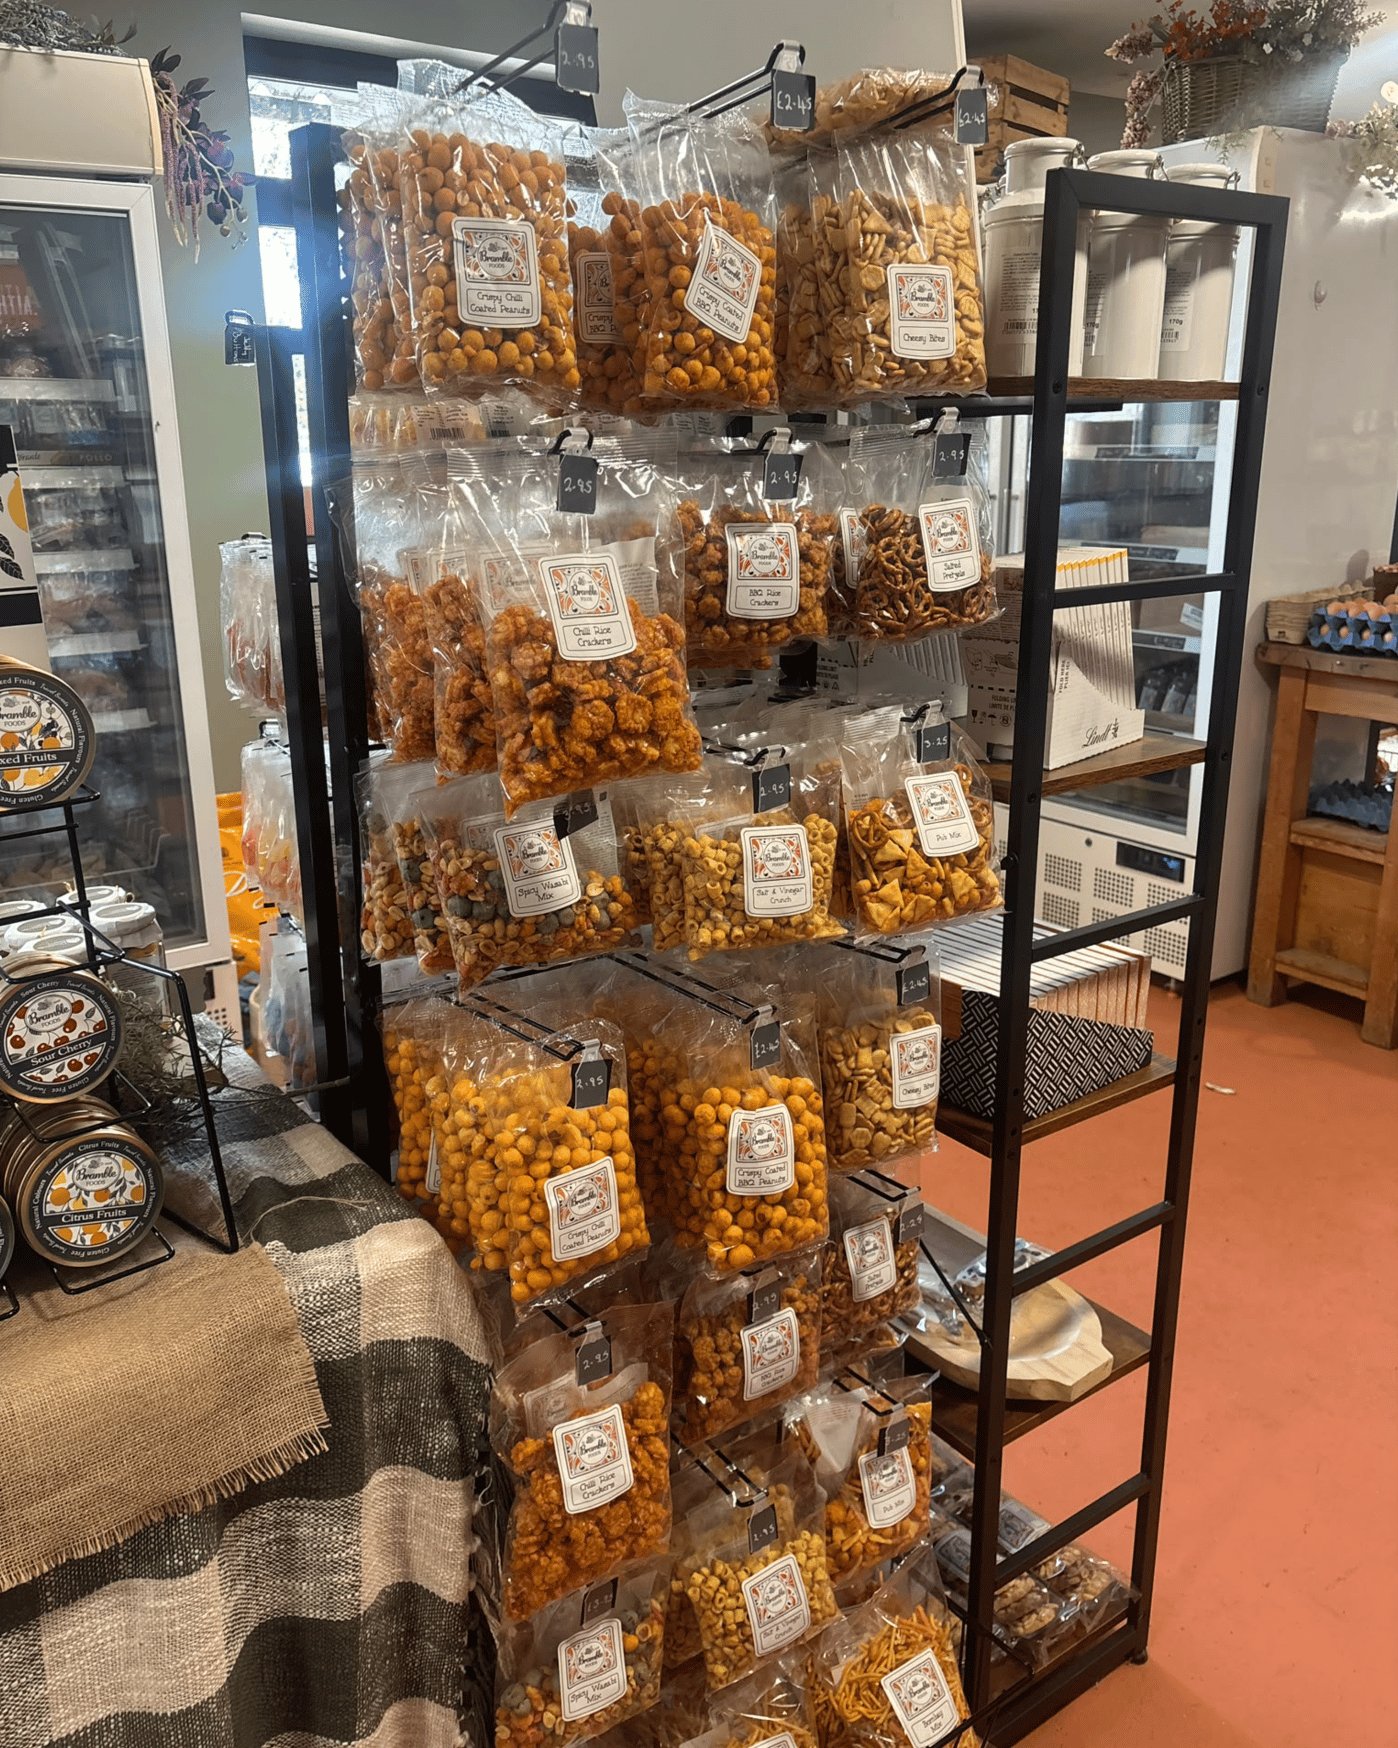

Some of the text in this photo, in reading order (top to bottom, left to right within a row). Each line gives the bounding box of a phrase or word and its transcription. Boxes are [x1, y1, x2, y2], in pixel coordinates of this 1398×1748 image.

[480, 251, 513, 263] Bramble
[720, 256, 741, 282] Bramble
[477, 292, 523, 304] Crispy Chilli
[910, 291, 935, 302] Bramble
[470, 304, 530, 314] Coated Peanuts
[699, 286, 743, 321] Crispy Coated
[695, 297, 740, 331] BBQ Peanuts
[1168, 317, 1183, 326] 170g
[903, 333, 945, 345] Cheesy Bites
[939, 450, 965, 462] 2.95
[770, 471, 797, 484] 2.95
[563, 477, 593, 493] 2.95
[937, 525, 958, 538] Bramble
[751, 549, 778, 561] Bramble
[944, 562, 961, 571] Salted
[943, 570, 966, 580] Pretzels
[571, 583, 598, 597] Bramble
[749, 589, 781, 597] BBQ Rice
[750, 598, 779, 607] Crackers
[572, 626, 611, 637] Chilli Rice
[578, 637, 612, 647] Crackers
[14, 677, 36, 686] Fruits
[992, 694, 1009, 702] FOLDING
[0, 705, 38, 720] ramble
[69, 708, 83, 734] Natural
[924, 735, 948, 748] 3.25
[1081, 724, 1113, 749] Lindt
[75, 735, 85, 764] Flavours
[24, 752, 57, 763] Fruits
[760, 783, 785, 797] 2.95
[18, 794, 44, 803] Gluten
[926, 796, 948, 807] Bramble
[936, 831, 962, 842] Pub Mix
[521, 847, 547, 860] Bramble
[765, 852, 790, 863] Bramble
[518, 878, 569, 898] Spicy Wasabi
[779, 886, 804, 897] Vinegar
[537, 892, 555, 902] Mix
[770, 896, 792, 904] Crunch
[20, 980, 60, 998] Sour Cherry
[28, 1004, 70, 1026] Bramble
[98, 994, 117, 1041] Natural Flavours
[41, 1018, 61, 1028] FOODS
[30, 1039, 93, 1067] Sour Cherry
[909, 1051, 928, 1062] Bramble
[51, 1076, 90, 1093] Gluten Free
[576, 1076, 604, 1089] 2.95
[902, 1085, 922, 1096] Cheesy
[78, 1140, 120, 1152] Citrus Fruits
[752, 1135, 775, 1146] Bramble
[76, 1166, 117, 1182] Bramble
[737, 1164, 786, 1178] Crispy Coated
[85, 1179, 106, 1187] FOODS
[738, 1176, 786, 1187] BBQ Peanuts
[143, 1168, 156, 1218] Natural Flavours
[570, 1191, 597, 1207] Bramble
[32, 1178, 47, 1230] Natural Colours
[61, 1207, 127, 1223] Citrus Fruits
[567, 1220, 606, 1243] Crispy Chilli
[561, 1227, 612, 1252] Coated Peanuts
[70, 1247, 110, 1258] Gluten Free
[761, 1338, 782, 1352] Bramble
[579, 1439, 607, 1457] Bramble
[579, 1471, 616, 1492] Chilli Rice
[582, 1481, 616, 1500] Crackers
[882, 1504, 894, 1514] Pub
[765, 1588, 786, 1605] Bramble
[774, 1627, 793, 1640] Crunch
[578, 1652, 603, 1666] Bramble
[570, 1678, 618, 1703] Spicy Wasabi
[908, 1681, 930, 1698] Bramble
[586, 1692, 603, 1704] Mix
[930, 1722, 943, 1733] Mix
